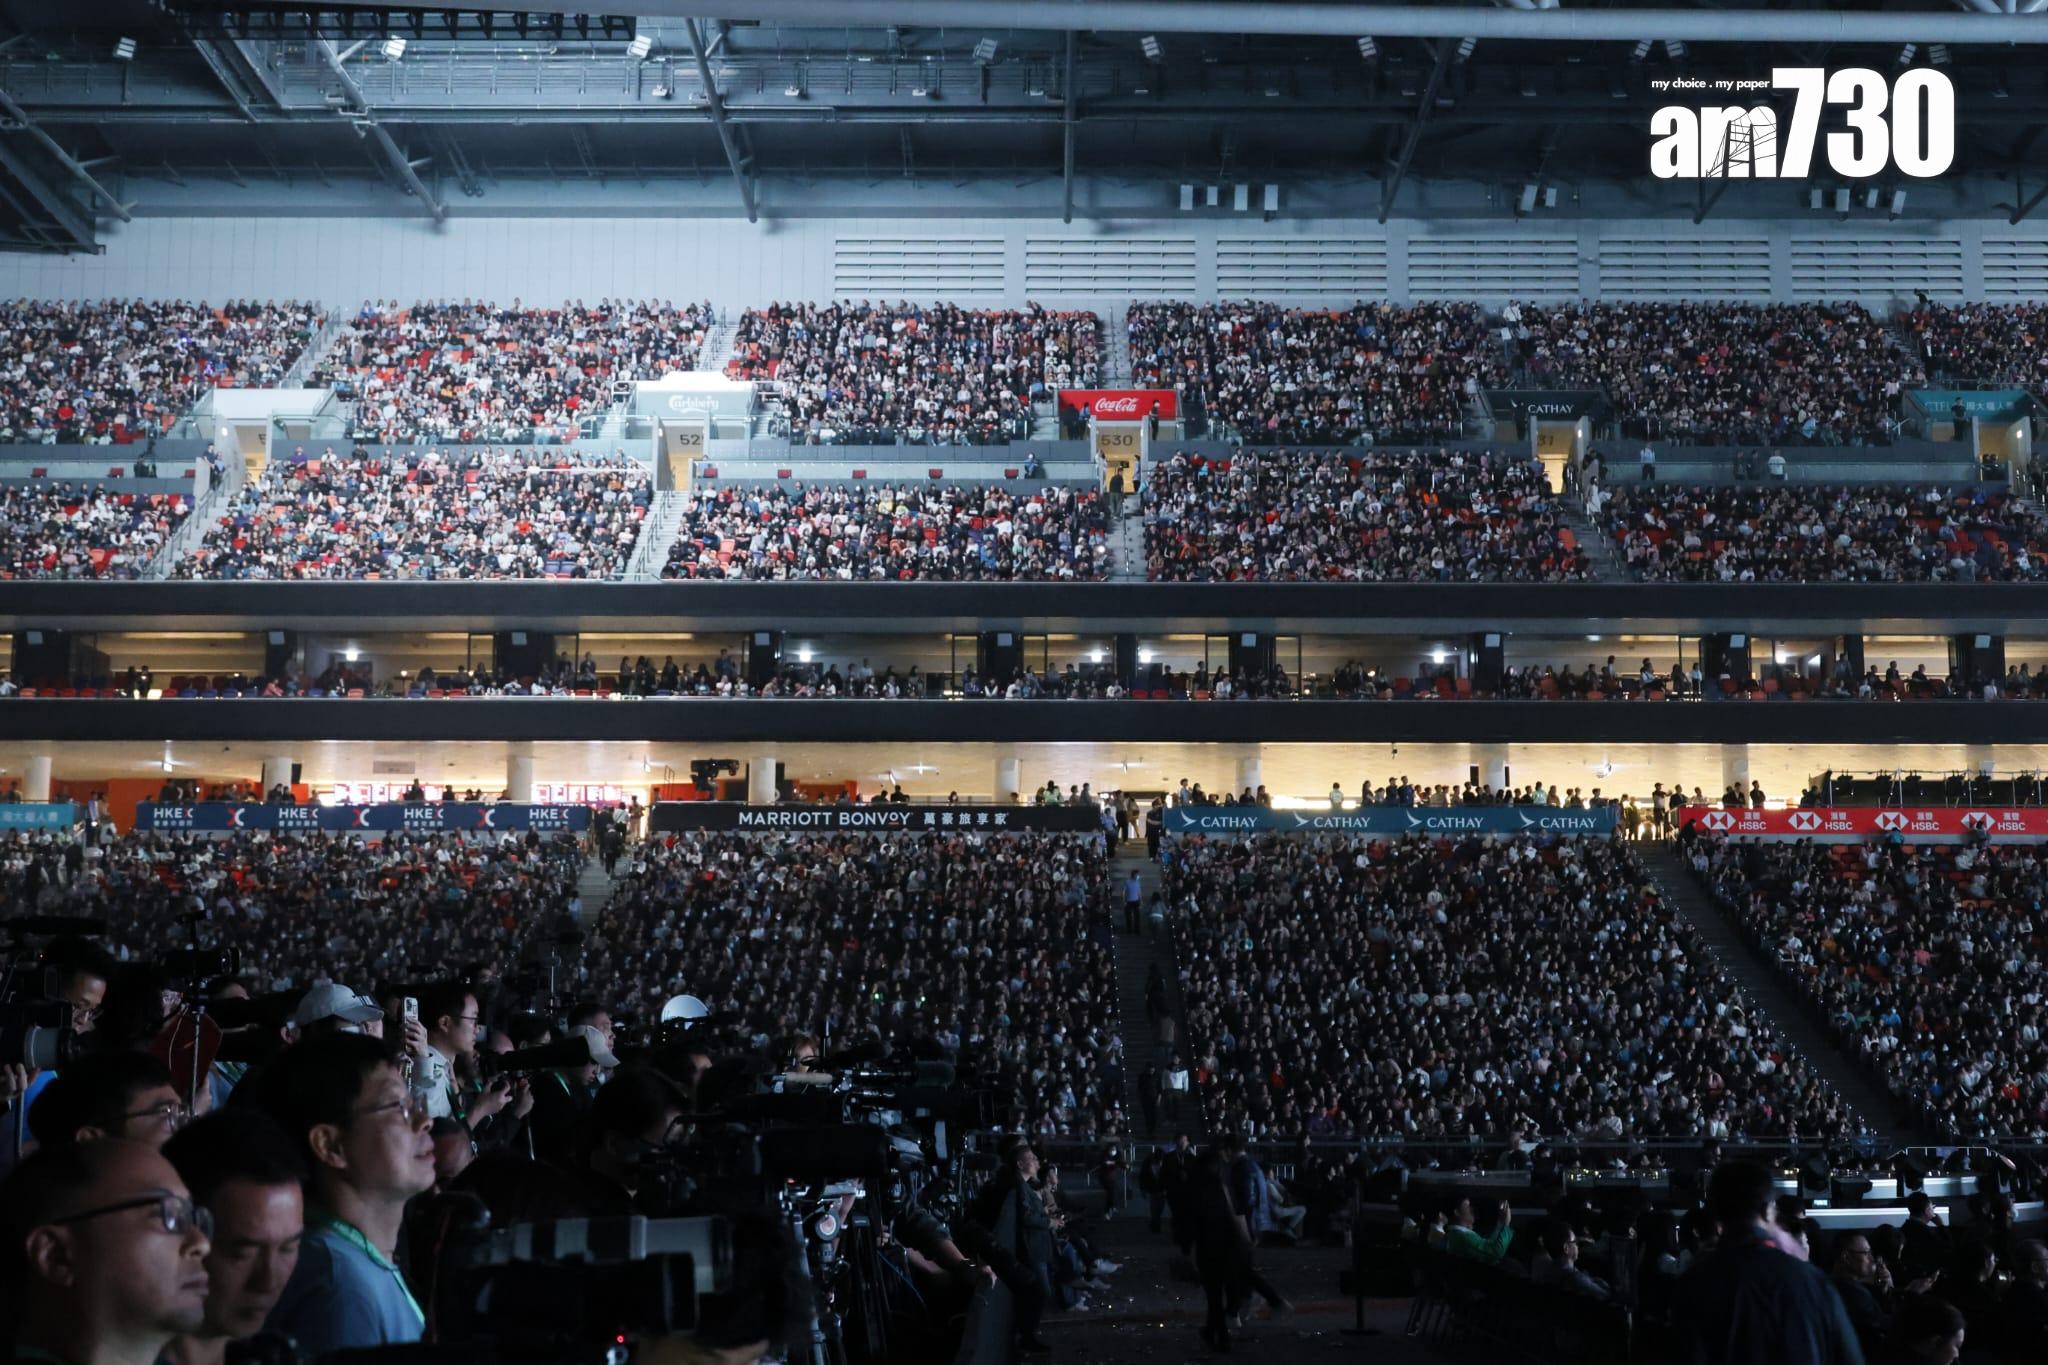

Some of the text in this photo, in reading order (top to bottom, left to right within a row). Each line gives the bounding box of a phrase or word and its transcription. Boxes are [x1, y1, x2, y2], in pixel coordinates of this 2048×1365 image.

[1528, 404, 1574, 413] CATHAY
[680, 434, 704, 446] 52
[1101, 434, 1133, 446] 530
[154, 808, 194, 818] HKEX
[279, 808, 319, 818] HKEX
[404, 808, 444, 818] HKEX
[529, 808, 569, 818] HKEX
[739, 811, 833, 825] MARRIOTT
[1201, 817, 1258, 828] CATHAY
[1314, 817, 1371, 828] CATHAY
[1427, 817, 1484, 828] CATHAY
[1540, 817, 1597, 828] CATHAY
[1739, 822, 1767, 831] HSBC
[1825, 822, 1853, 831] HSBC
[1912, 822, 1940, 831] HSBC
[1998, 822, 2026, 831] HSBC
